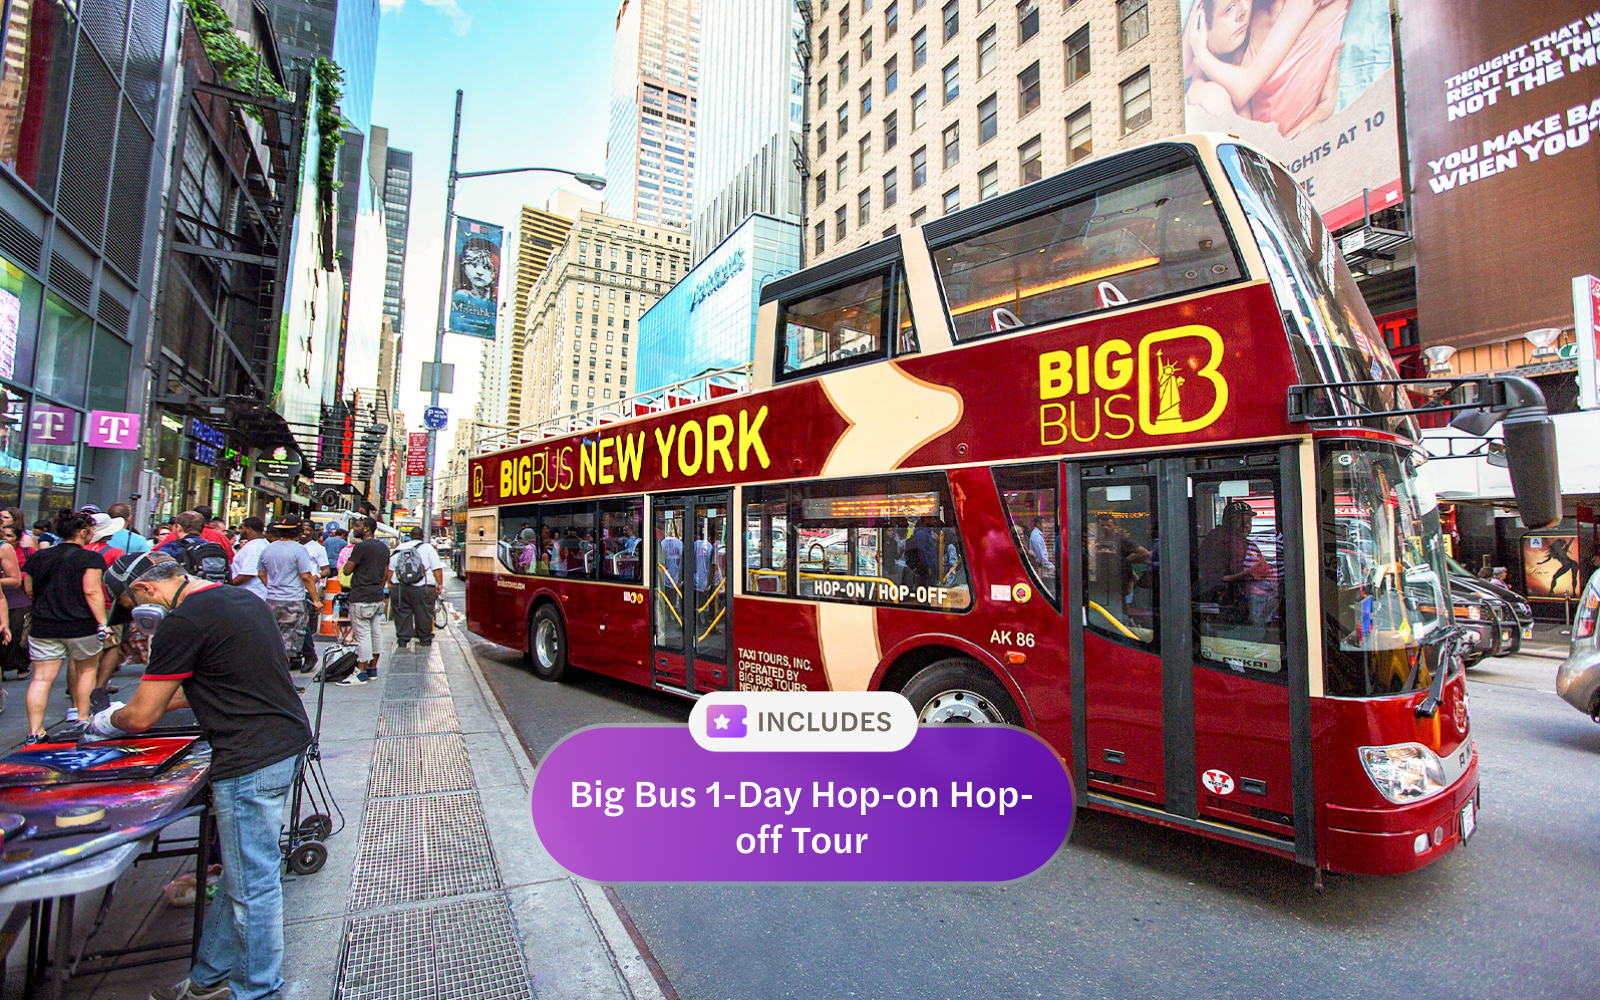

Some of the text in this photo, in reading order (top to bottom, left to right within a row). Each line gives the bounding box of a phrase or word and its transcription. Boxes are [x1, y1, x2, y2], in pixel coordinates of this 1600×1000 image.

[1444, 44, 1529, 90] THOUGHT
[1530, 19, 1584, 52] THAT
[1446, 69, 1504, 105] RENT
[1506, 49, 1554, 80] FOR
[1447, 44, 1600, 122] NOT THE M
[1336, 125, 1358, 150] AT
[1364, 110, 1386, 133] 10
[1427, 144, 1478, 175] YOU
[1482, 113, 1563, 157] MAKE
[1428, 119, 1600, 195] WHEN YOU'
[1039, 338, 1134, 400] BIG
[579, 431, 646, 486] NEW
[655, 405, 771, 479] YORK
[1039, 393, 1135, 446] BUS
[814, 580, 866, 599] HOP-ON
[879, 584, 948, 604] HOP-OFF
[738, 647, 813, 671] TAXI TOURS, INC.
[990, 629, 1035, 648] AK 86
[738, 660, 799, 682] OPERATED BY
[738, 671, 754, 683] BIG
[755, 674, 773, 688] BUS
[774, 678, 808, 692] TOURS
[1208, 780, 1229, 789] VECTOR
